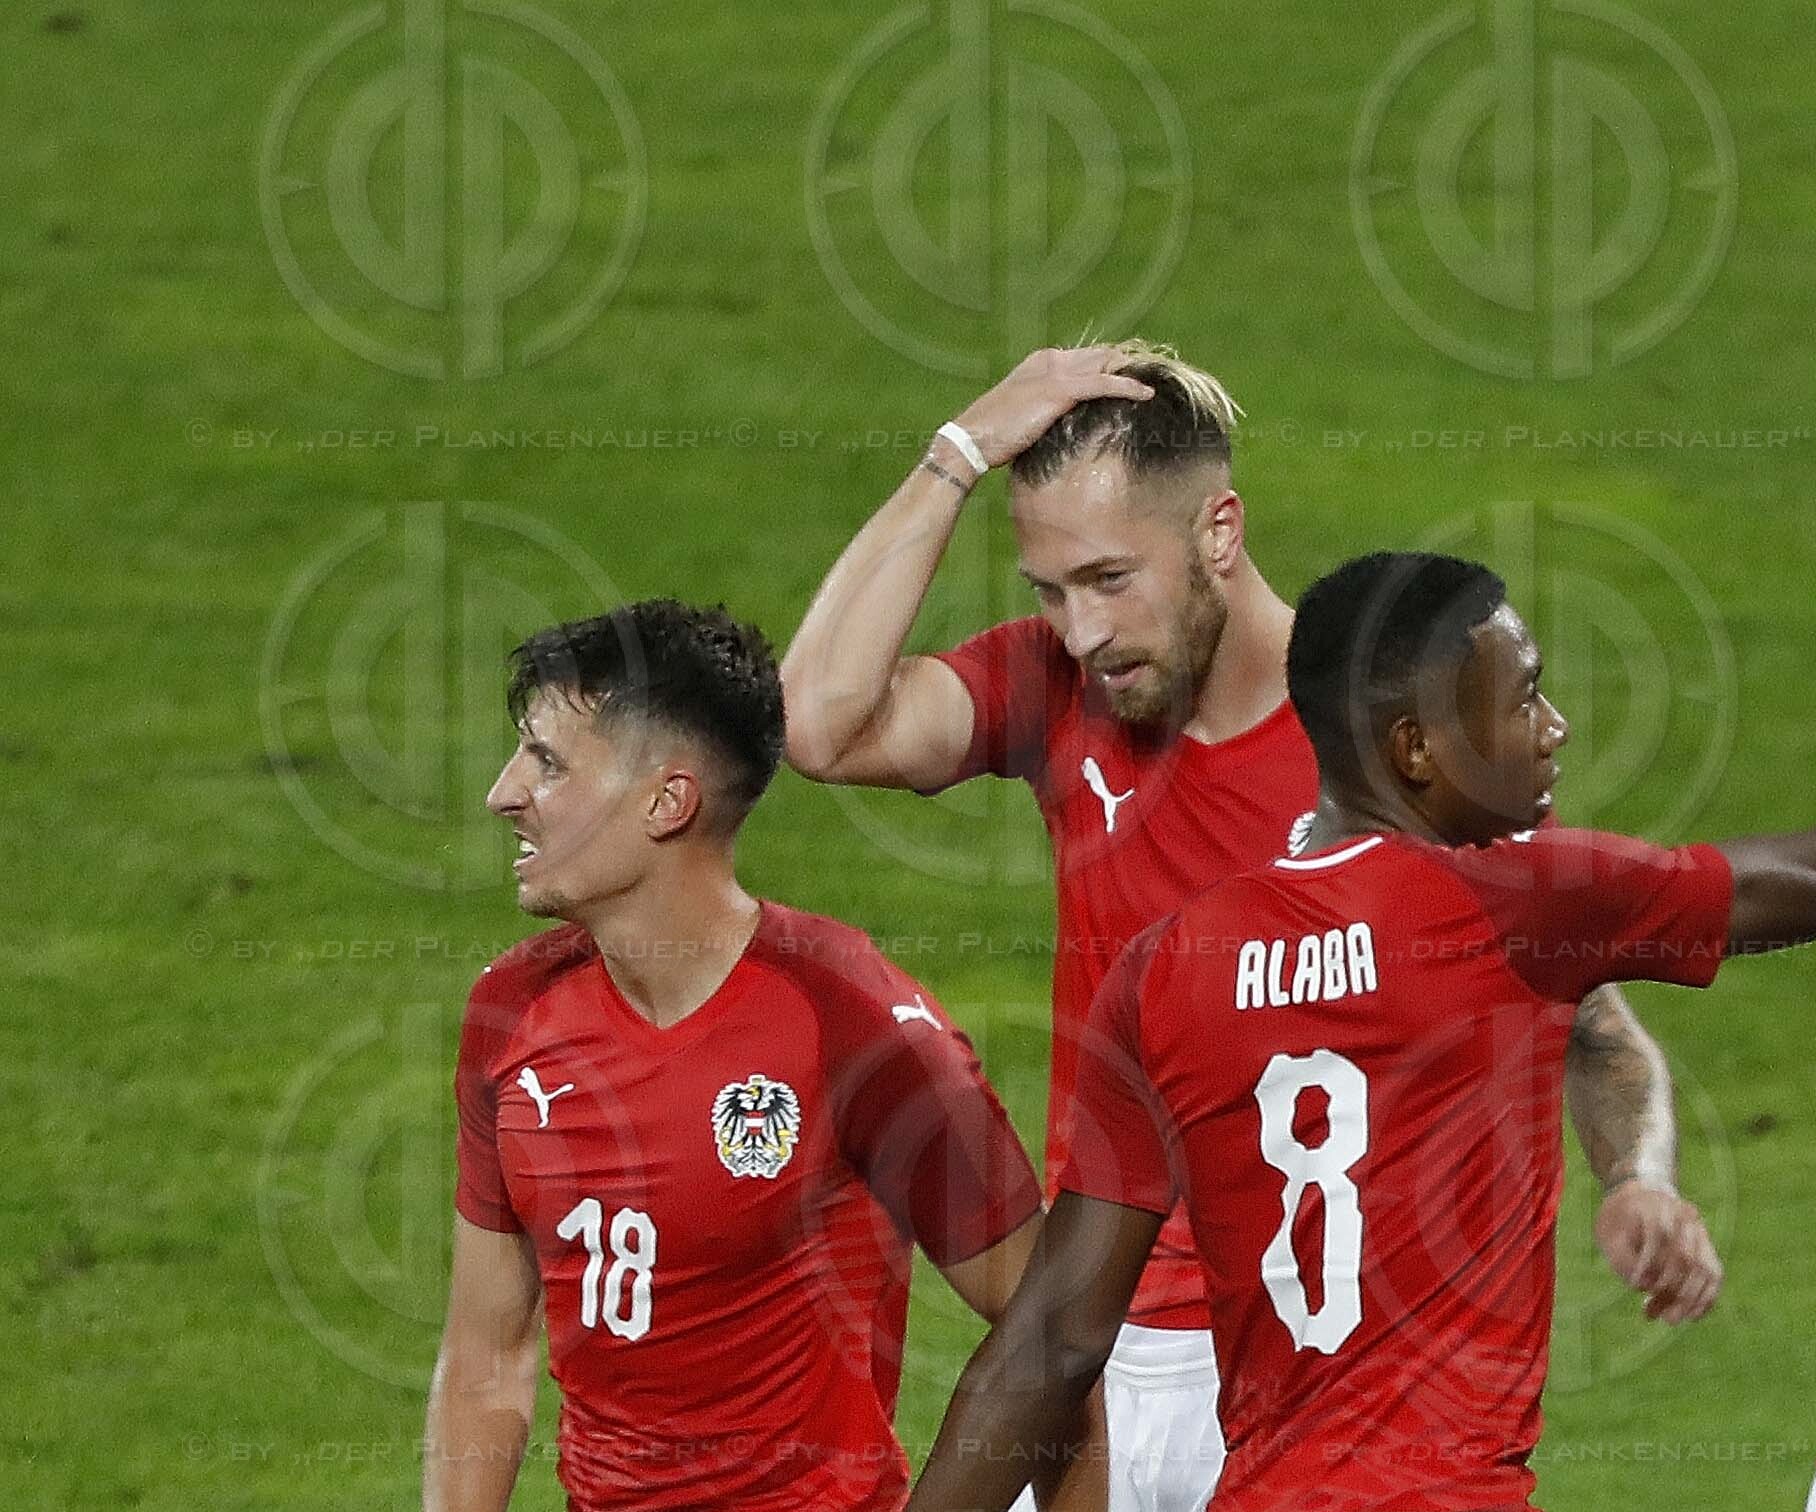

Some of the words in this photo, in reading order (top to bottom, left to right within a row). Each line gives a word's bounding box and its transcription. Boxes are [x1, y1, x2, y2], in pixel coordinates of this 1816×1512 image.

[1235, 921, 1378, 1010] ALABA
[557, 1198, 658, 1342] 18
[1253, 1049, 1369, 1355] 8
